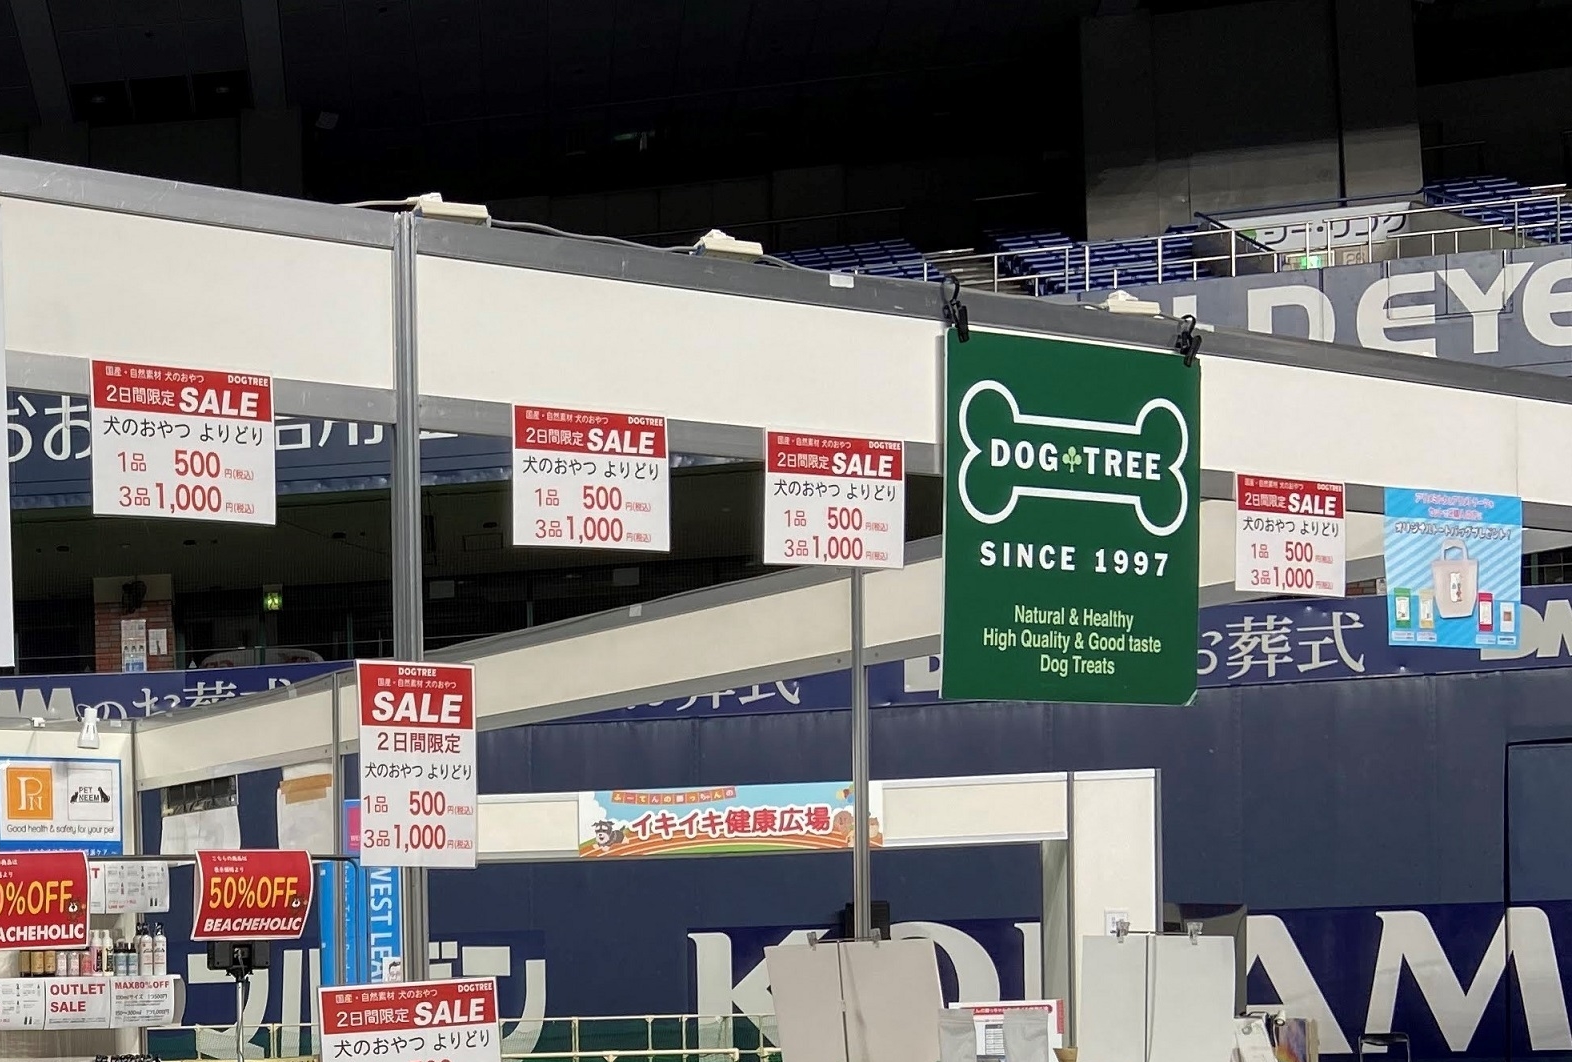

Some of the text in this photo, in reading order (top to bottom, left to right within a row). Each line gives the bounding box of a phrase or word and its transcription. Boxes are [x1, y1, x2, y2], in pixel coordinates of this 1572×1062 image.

[228, 375, 268, 387] DOGTREE
[106, 385, 258, 417] 2日間限定 SALE
[104, 416, 190, 439] 犬のおやつ
[199, 425, 264, 446] よりどり
[526, 428, 654, 454] 2日間限定 SALE
[117, 451, 147, 471] 1品
[523, 457, 659, 480] 犬のおやつ よりどり
[778, 452, 892, 477] 2日間限定 SALE
[990, 437, 1161, 480] DOG TREE
[774, 480, 896, 501] 犬のおやつ よりどり
[1288, 493, 1336, 515] SALE
[1243, 516, 1339, 537] 犬のおやつ よりどり
[980, 541, 1169, 576] SINCE 1997
[1014, 605, 1134, 632] Natural & Healthy
[983, 628, 1161, 653] High Quality & Good taste
[398, 667, 437, 677] DOGTREE
[1040, 654, 1115, 676] Dog Treats
[371, 691, 462, 725] SALE
[377, 732, 461, 755] 2日間限定
[364, 762, 472, 781] 犬のおやつ よりどり
[7, 825, 27, 833] Good
[56, 825, 76, 834] safety
[78, 825, 86, 833] for
[88, 826, 102, 835] your
[103, 826, 114, 835] pet
[633, 807, 831, 838] イキイキ健康広場
[209, 876, 299, 910] 50%OFF
[203, 918, 302, 932] BEACHEHOLIC
[50, 984, 105, 995] OUTLET
[115, 981, 169, 989] MAX80%OFF
[50, 1001, 86, 1012] SALE
[336, 998, 485, 1028] 2日間限定 SALE
[334, 1028, 490, 1059] 犬のおやつ よりどり
